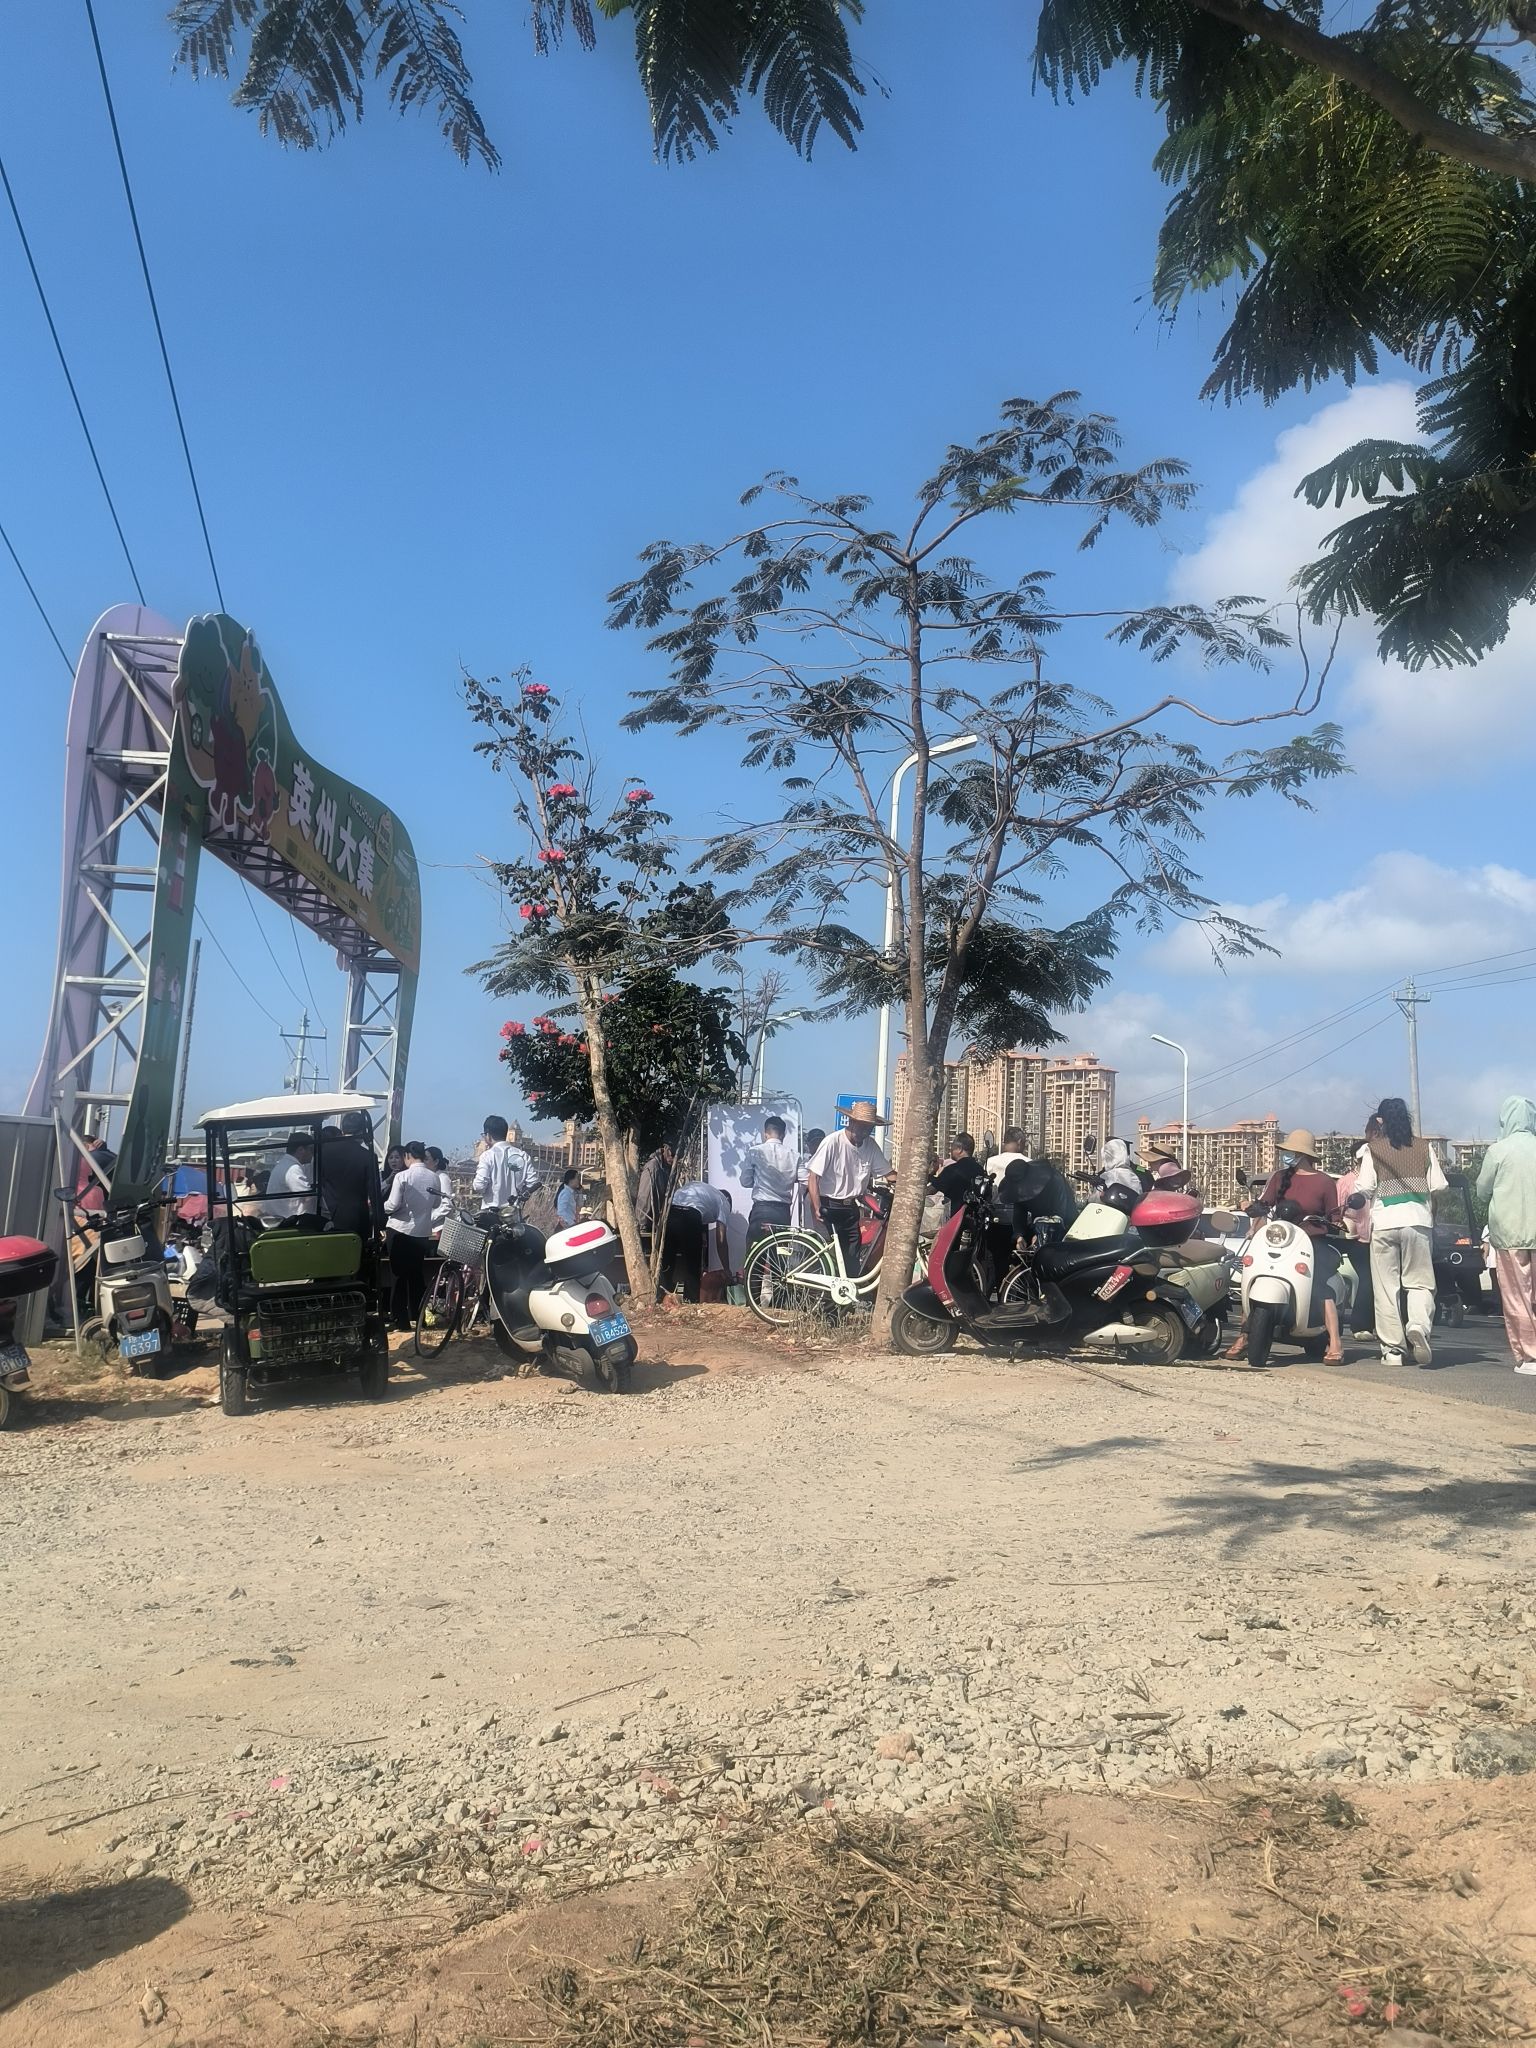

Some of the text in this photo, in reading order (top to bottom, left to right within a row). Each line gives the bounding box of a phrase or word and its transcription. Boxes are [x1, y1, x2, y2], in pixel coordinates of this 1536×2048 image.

[288, 760, 375, 902] 英州大集
[595, 1324, 628, 1343] 0184529
[125, 1339, 158, 1356] 16397
[0, 1354, 29, 1374] 8W09
